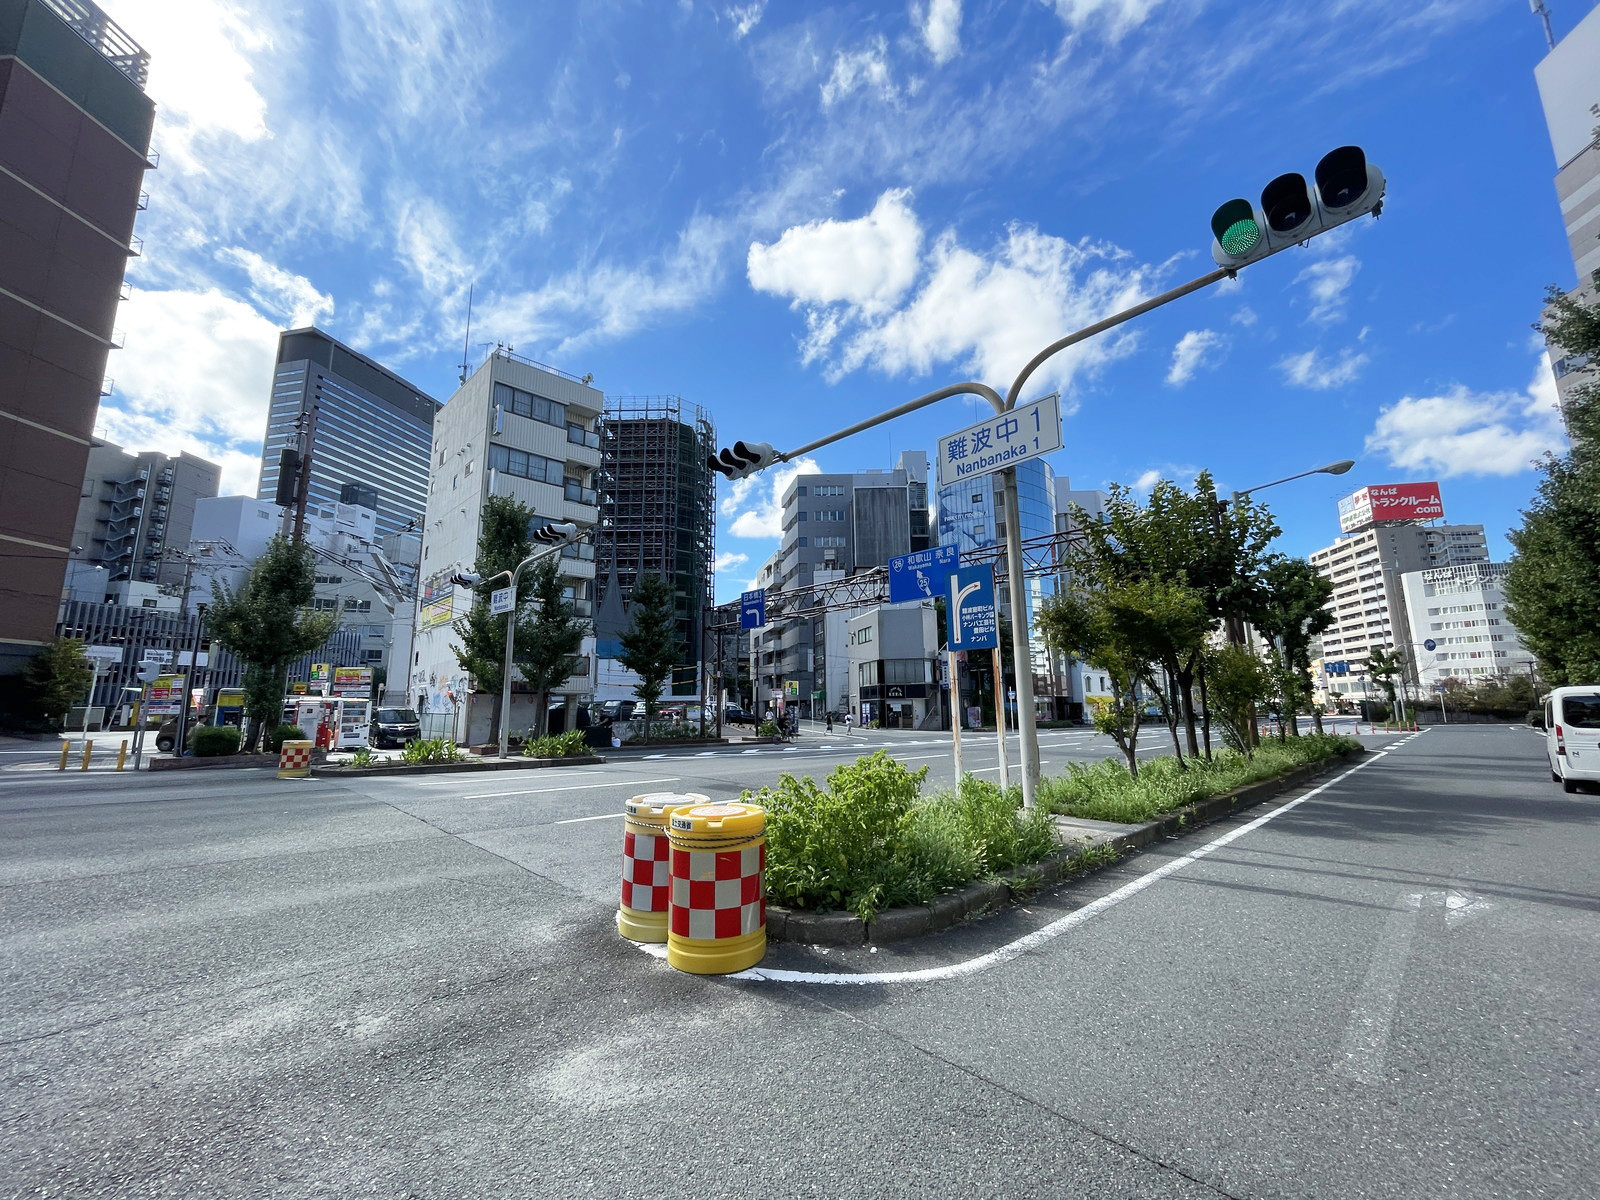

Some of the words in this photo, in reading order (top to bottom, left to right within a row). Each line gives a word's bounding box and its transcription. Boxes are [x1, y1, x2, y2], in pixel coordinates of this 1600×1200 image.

[947, 418, 1018, 464] 難波中
[1030, 406, 1041, 432] 1
[956, 443, 1027, 477] Nanbanaka
[1032, 436, 1039, 450] 1
[1370, 488, 1397, 497] なんば
[1372, 495, 1440, 507] トランクルーム
[1413, 506, 1441, 514] .com
[907, 552, 932, 565] 和歌山
[935, 547, 955, 559] 奈良
[893, 560, 901, 570] 26
[908, 562, 932, 571] Wakayama
[919, 578, 928, 587] 25
